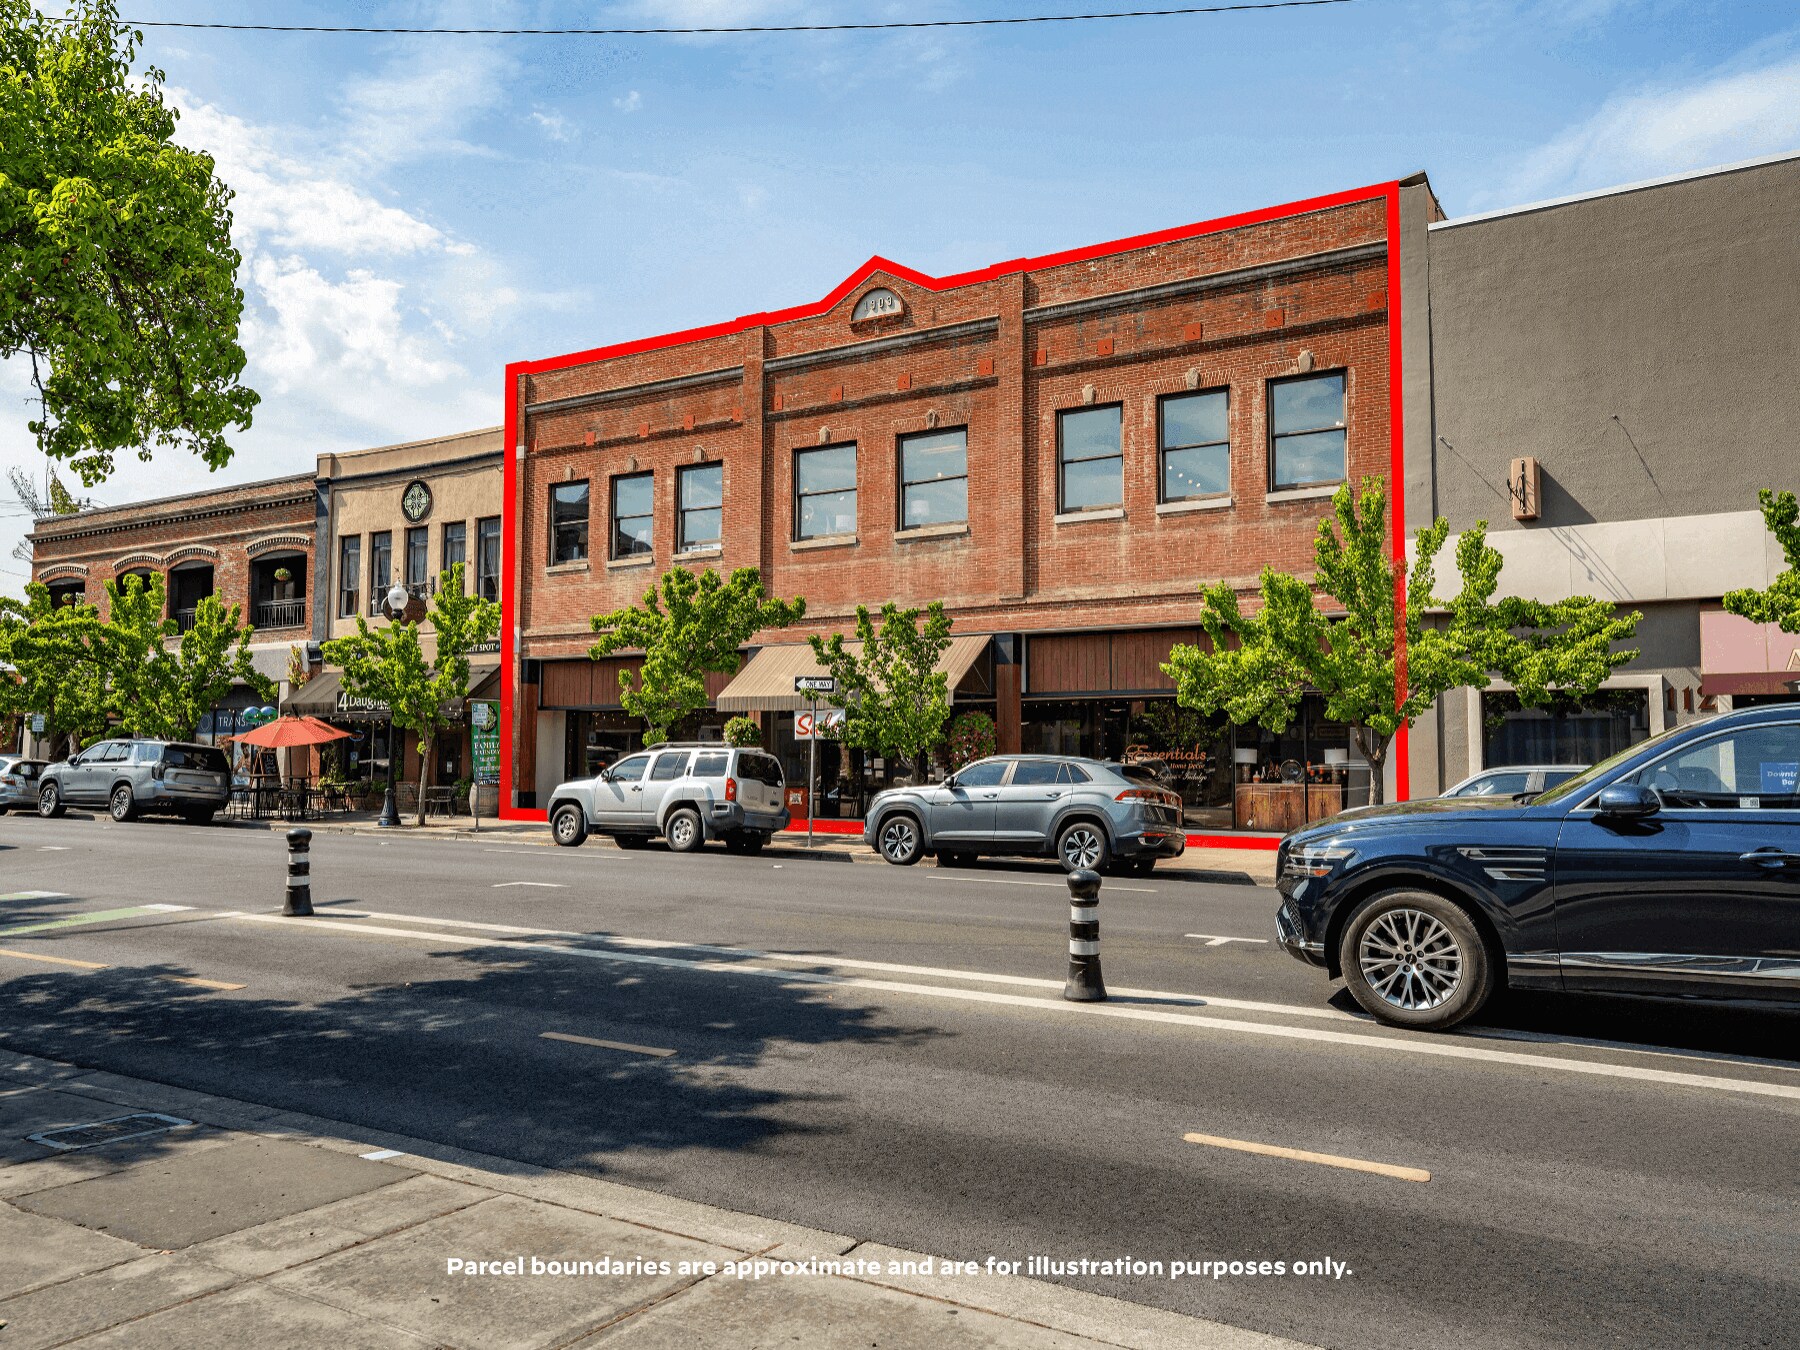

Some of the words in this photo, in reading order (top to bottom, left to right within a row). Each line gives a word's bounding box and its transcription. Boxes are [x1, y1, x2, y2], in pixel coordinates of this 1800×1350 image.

[479, 643, 496, 651] SPOT
[338, 692, 349, 711] 4
[1666, 685, 1716, 711] 112
[1125, 743, 1207, 761] Essentials
